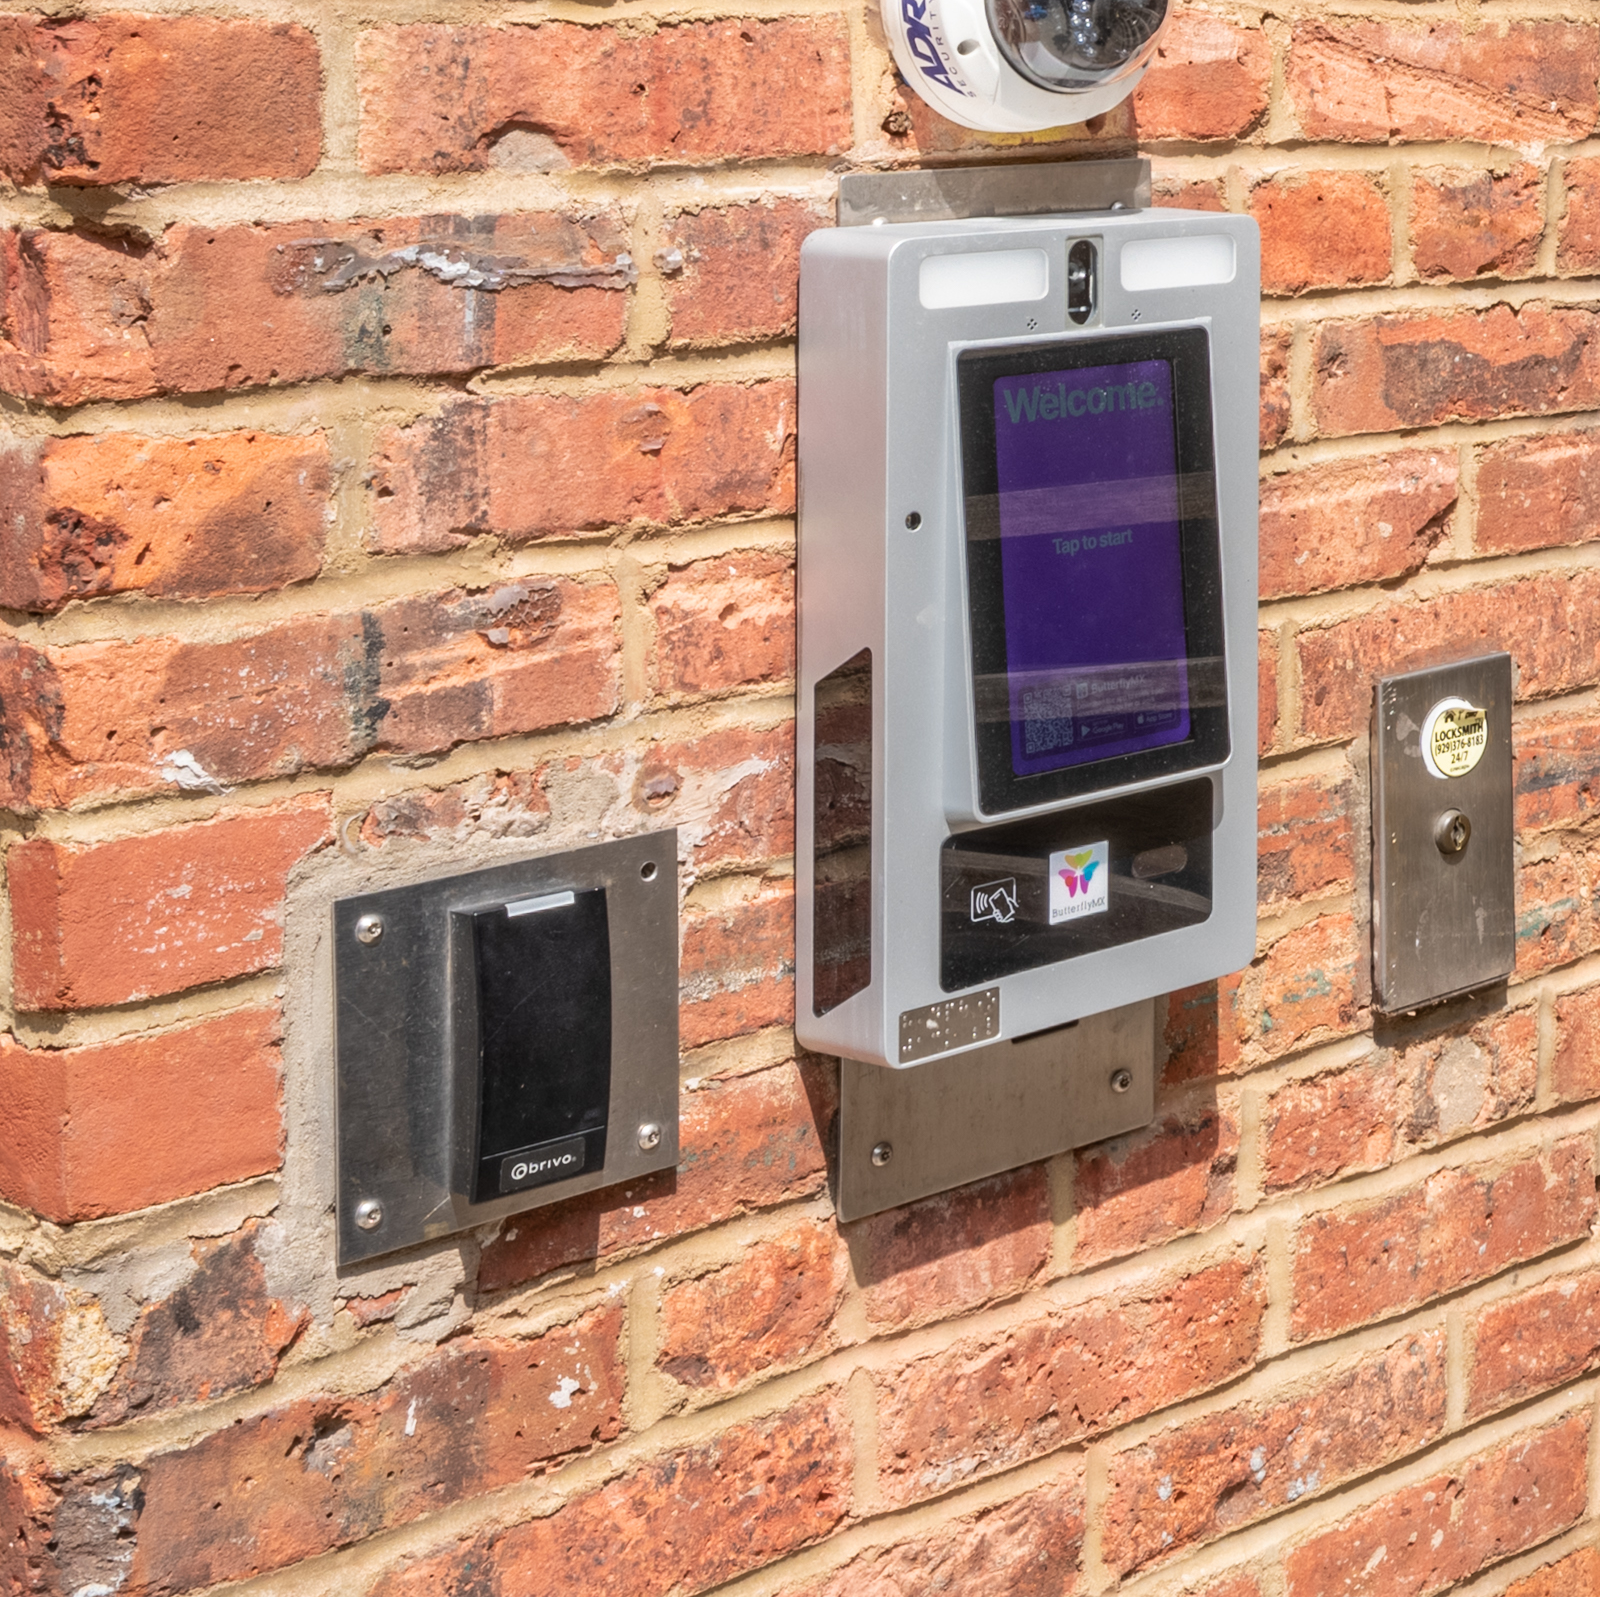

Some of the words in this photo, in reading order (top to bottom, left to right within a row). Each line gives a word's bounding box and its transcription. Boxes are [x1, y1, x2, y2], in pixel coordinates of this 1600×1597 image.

[1003, 381, 1165, 424] Welcome.
[1052, 537, 1080, 556] Tap
[1082, 535, 1098, 550] to
[1100, 528, 1133, 548] start
[1091, 674, 1147, 695] ButterflyMX
[1435, 723, 1484, 743] LOCKSMITH
[1435, 734, 1484, 756] (929)376-8183
[1451, 750, 1469, 764] 24/7
[1052, 896, 1106, 918] ButterflyMX
[528, 1153, 573, 1175] brivo
